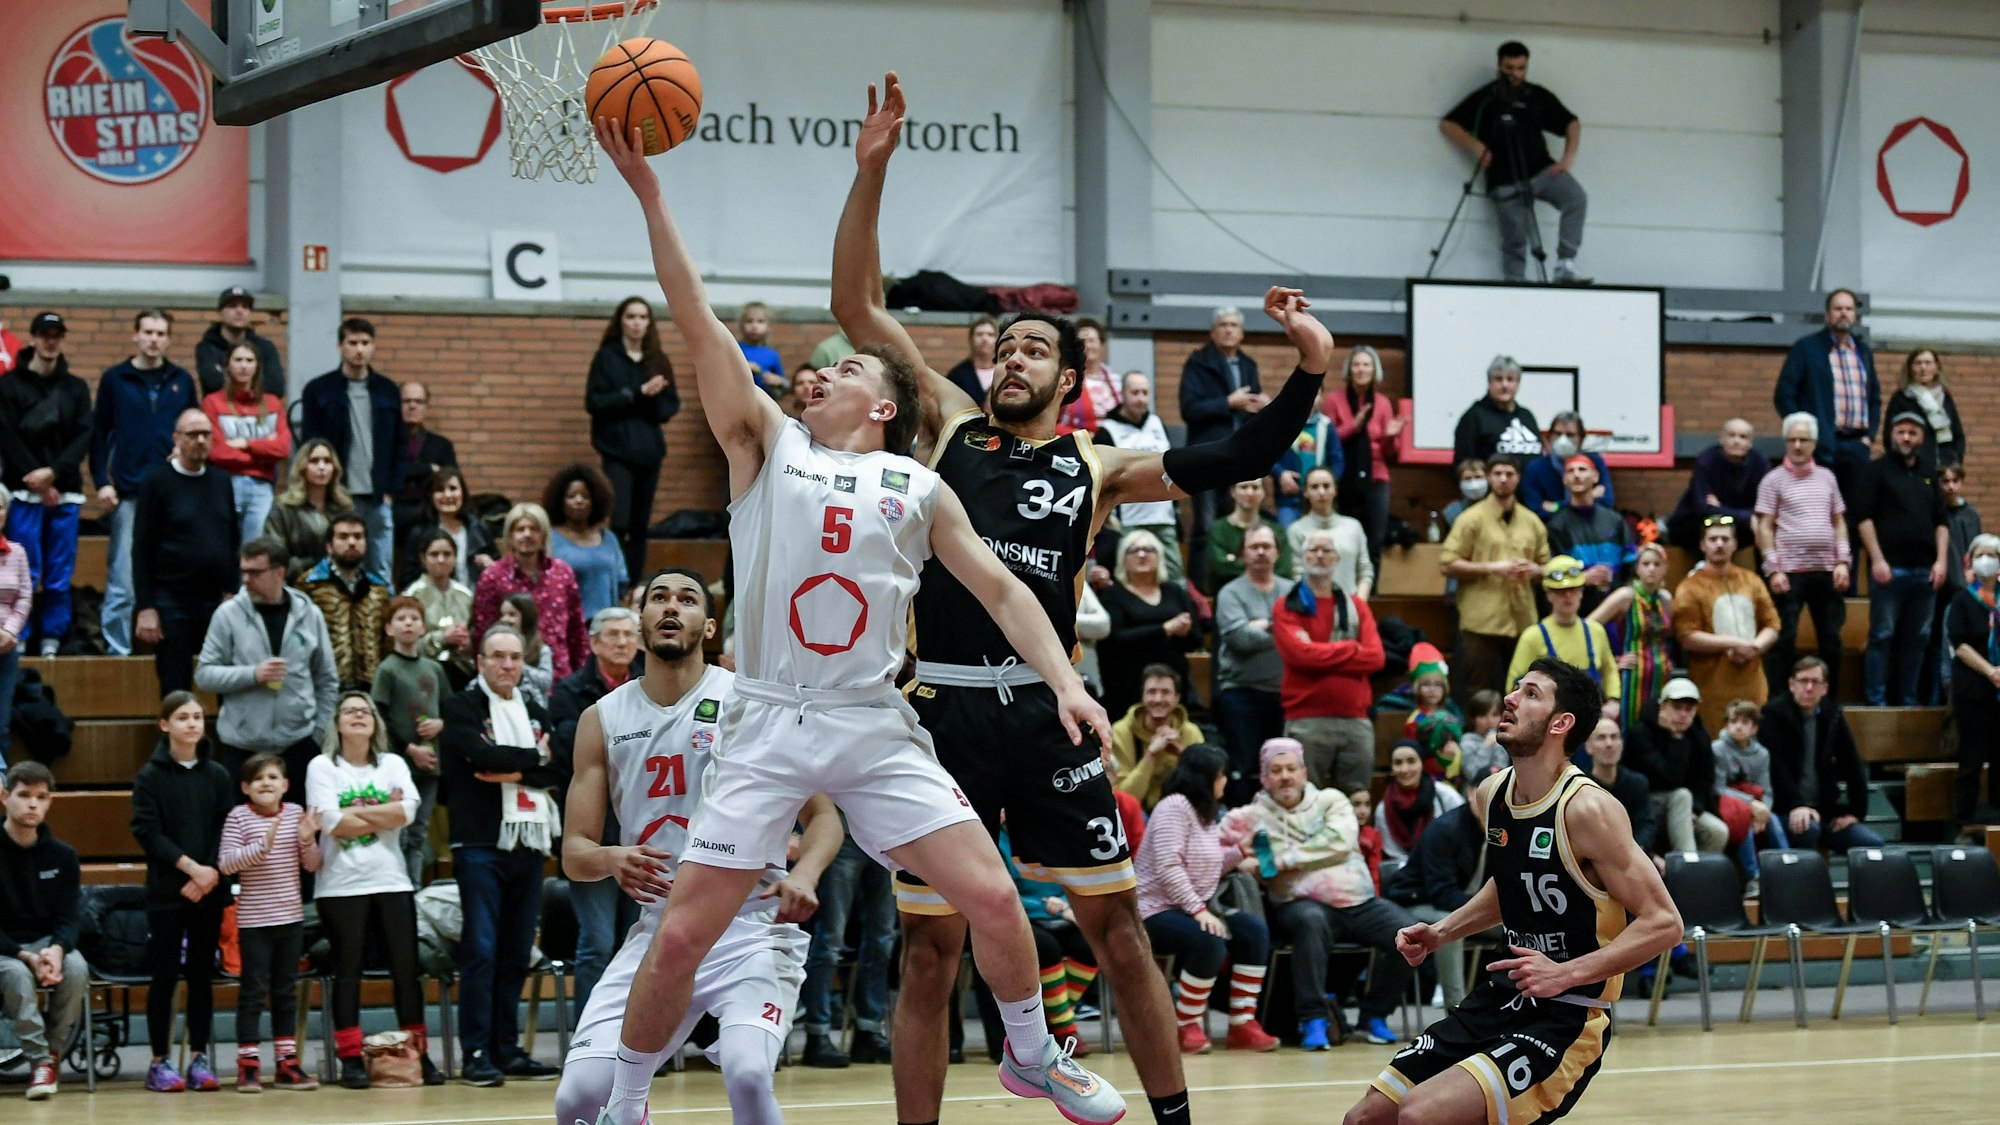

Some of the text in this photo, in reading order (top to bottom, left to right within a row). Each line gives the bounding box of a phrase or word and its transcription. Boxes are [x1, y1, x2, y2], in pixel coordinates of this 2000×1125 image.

[47, 80, 147, 118] RHEIN
[95, 111, 199, 148] STARS
[899, 112, 1020, 153] torch
[505, 241, 548, 289] C
[1017, 479, 1087, 527] 34
[821, 505, 854, 554] 5
[613, 729, 652, 746] SPALDING
[645, 752, 687, 798] 21
[951, 787, 970, 808] 5
[691, 837, 736, 855] SPALDING
[1520, 872, 1568, 915] 16
[761, 1002, 782, 1026] 21
[1491, 1042, 1533, 1091] 16
